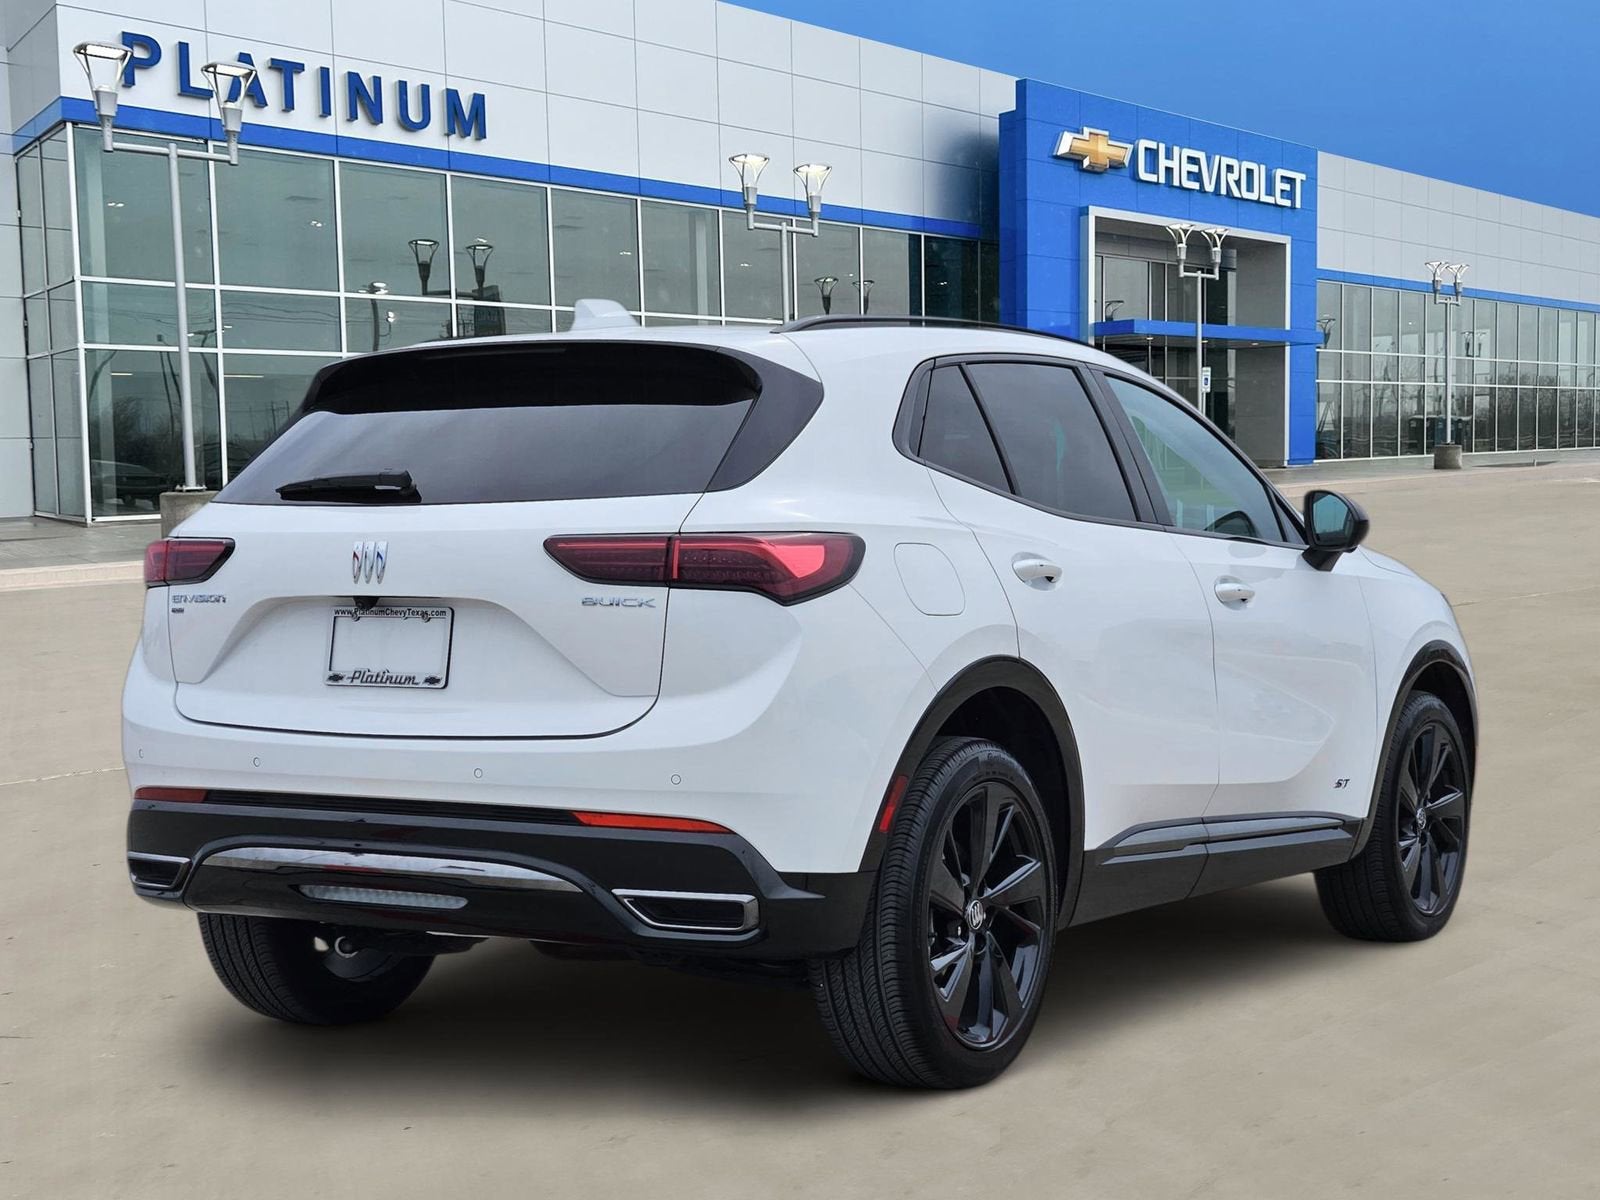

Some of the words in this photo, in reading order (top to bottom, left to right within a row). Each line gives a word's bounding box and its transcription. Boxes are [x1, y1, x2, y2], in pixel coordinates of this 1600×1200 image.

[121, 31, 486, 140] PLATINUM
[1135, 138, 1307, 209] CHEVROLET
[171, 594, 226, 604] ENVISION
[582, 597, 656, 609] BUICK
[346, 669, 420, 685] Platinum
[1333, 778, 1351, 789] ST
